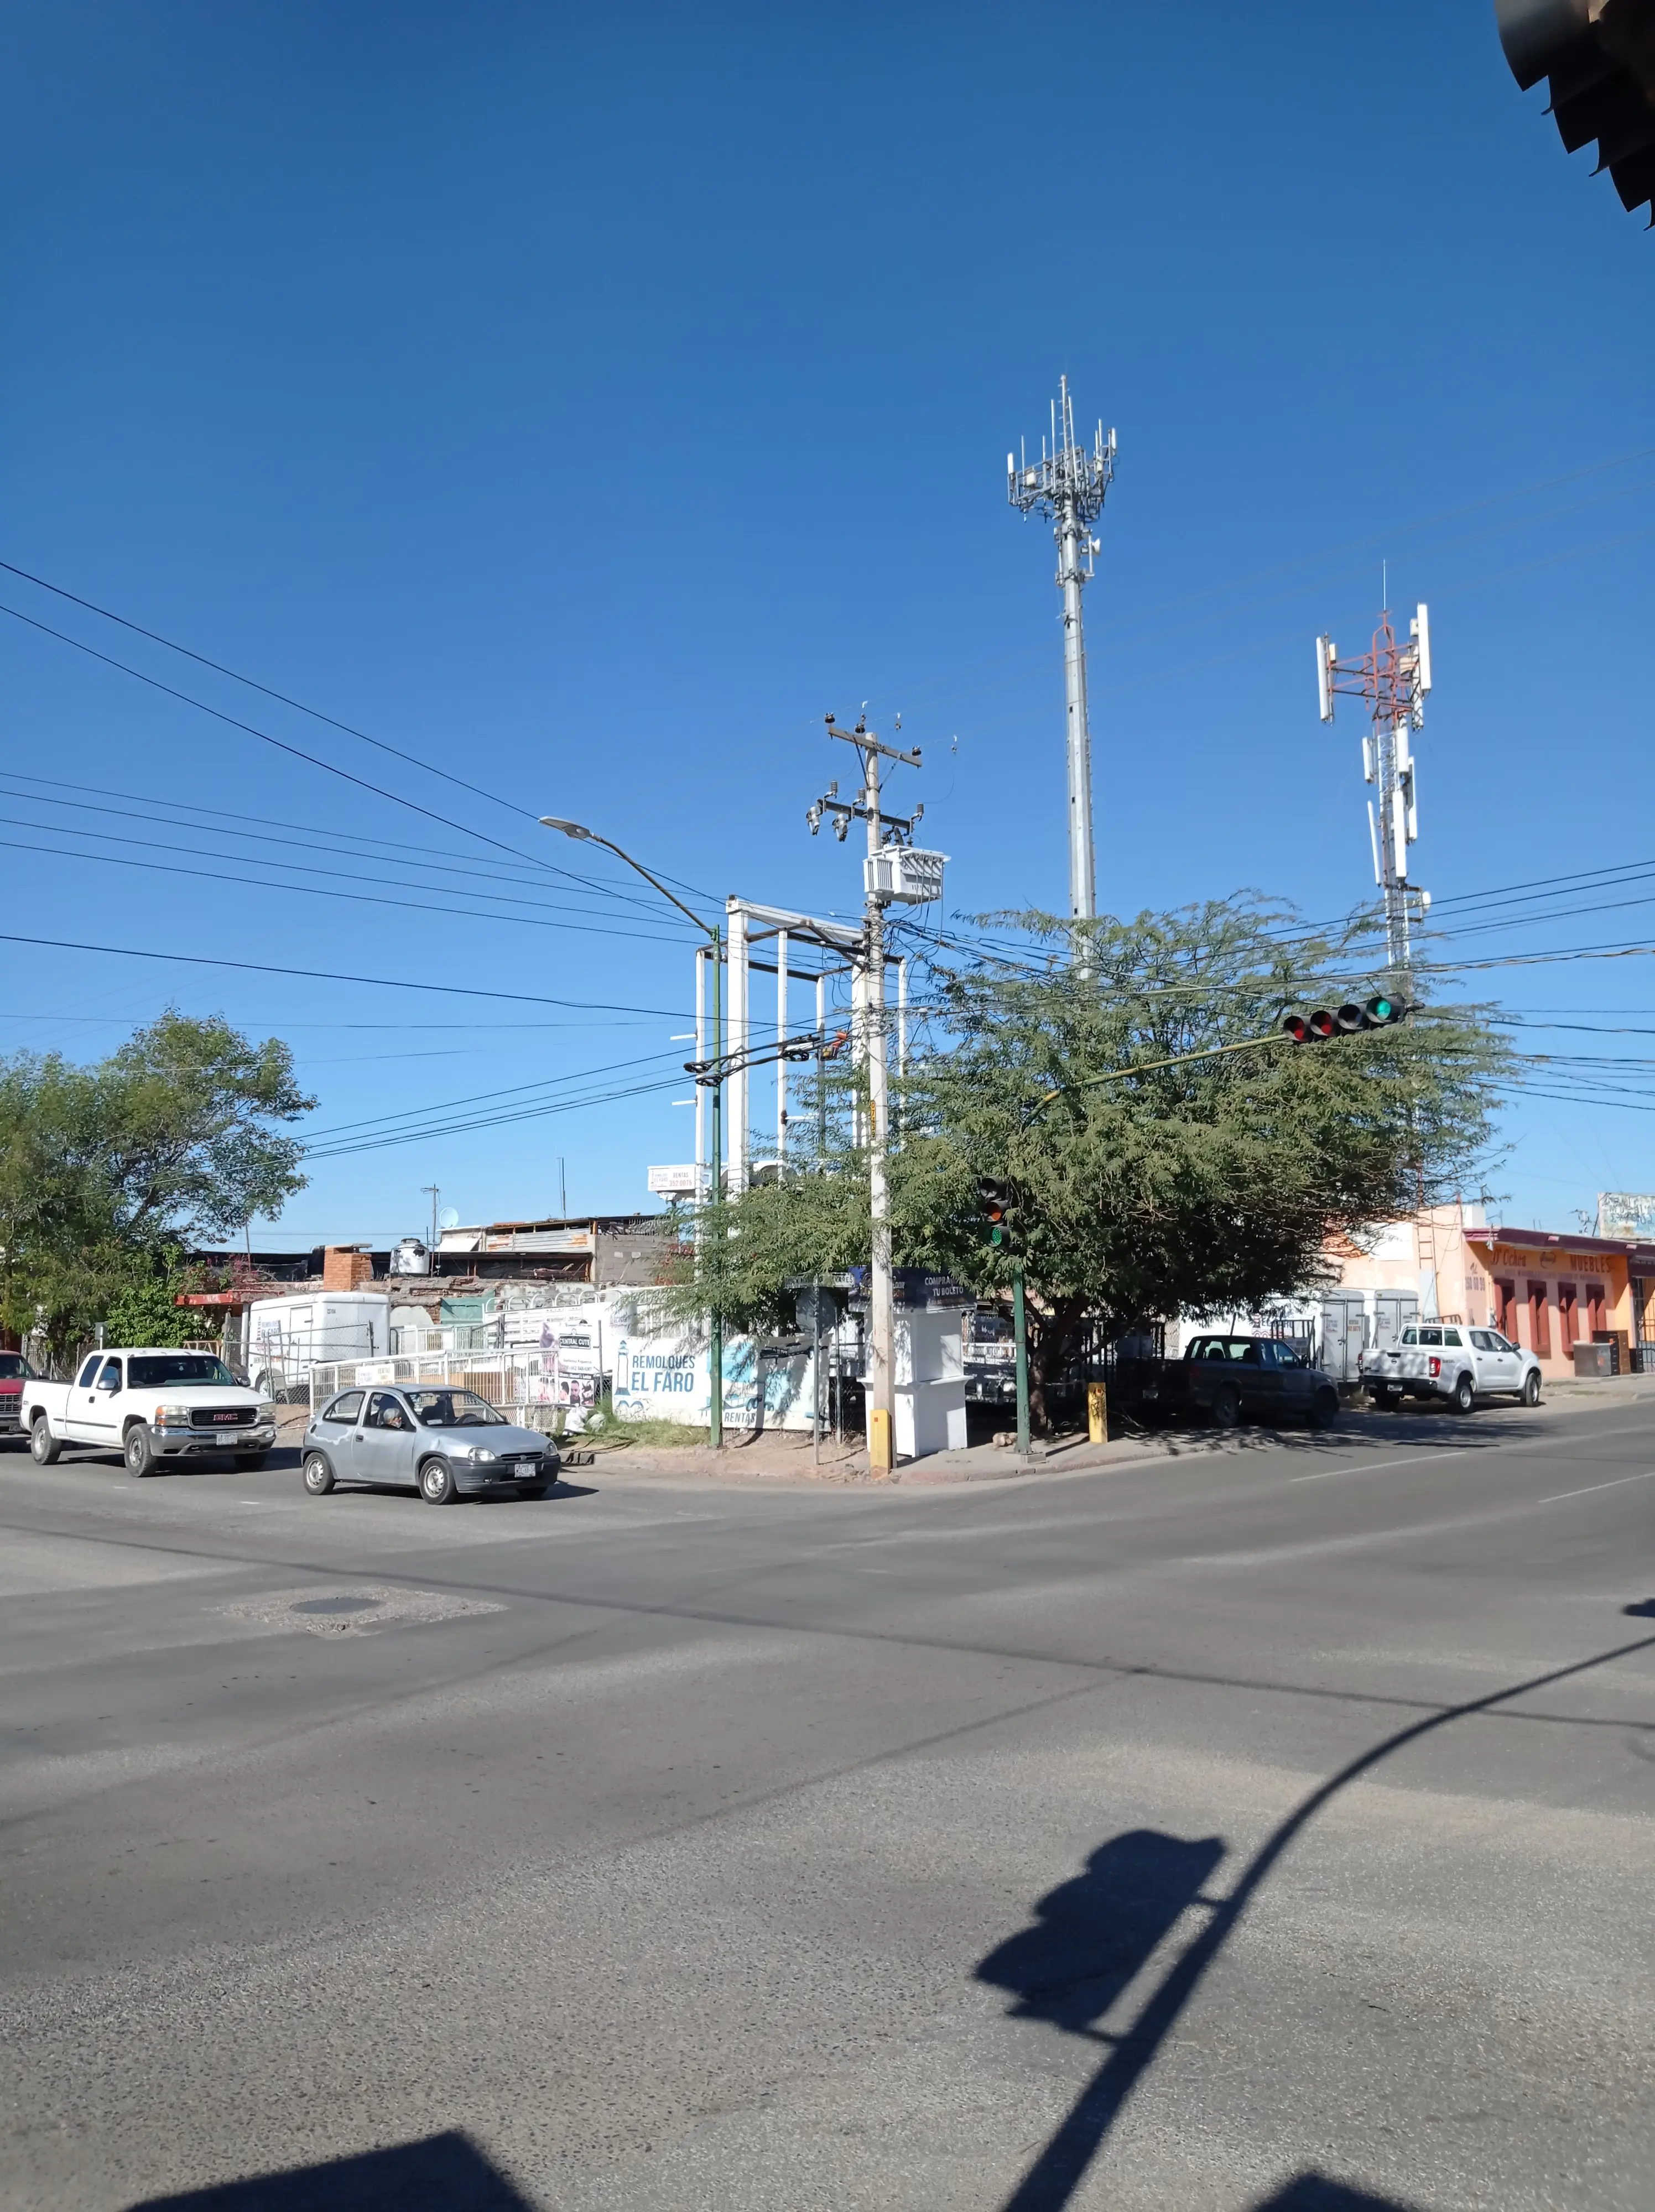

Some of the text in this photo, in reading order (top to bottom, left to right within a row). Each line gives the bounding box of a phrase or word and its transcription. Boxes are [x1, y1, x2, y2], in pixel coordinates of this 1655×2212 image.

[1570, 1254, 1611, 1273] MUEBLES
[924, 1276, 950, 1286] COMPRA
[933, 1286, 964, 1297] TU BOLETO
[632, 1355, 695, 1369] REMOLQUES
[631, 1371, 694, 1392] EL FARO
[724, 1412, 756, 1423] RENTAS
